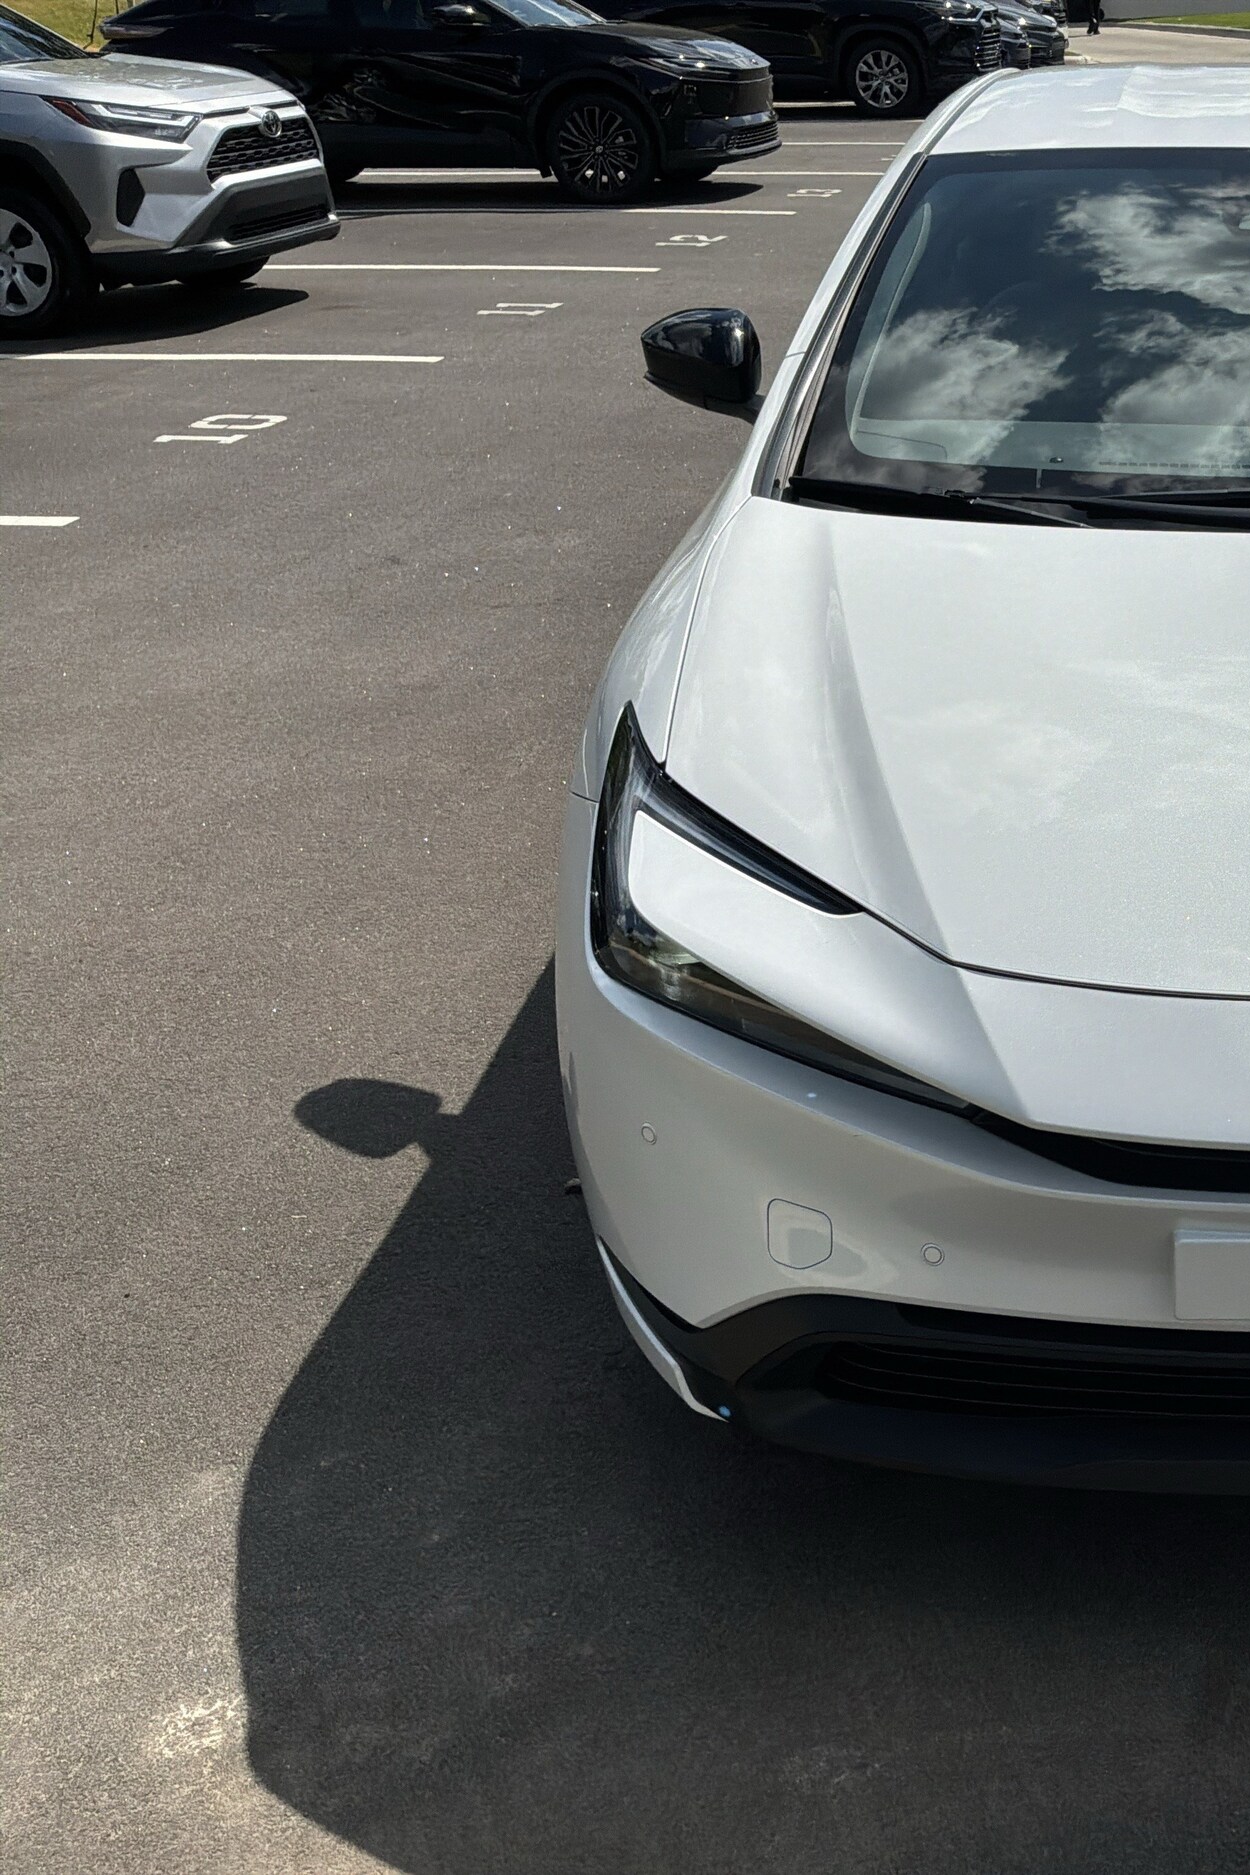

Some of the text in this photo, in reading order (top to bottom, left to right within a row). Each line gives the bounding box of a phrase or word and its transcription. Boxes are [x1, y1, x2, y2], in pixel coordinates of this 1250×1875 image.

[786, 188, 842, 198] 13
[655, 234, 728, 247] 12
[476, 302, 564, 316] 11
[153, 413, 288, 444] 10
